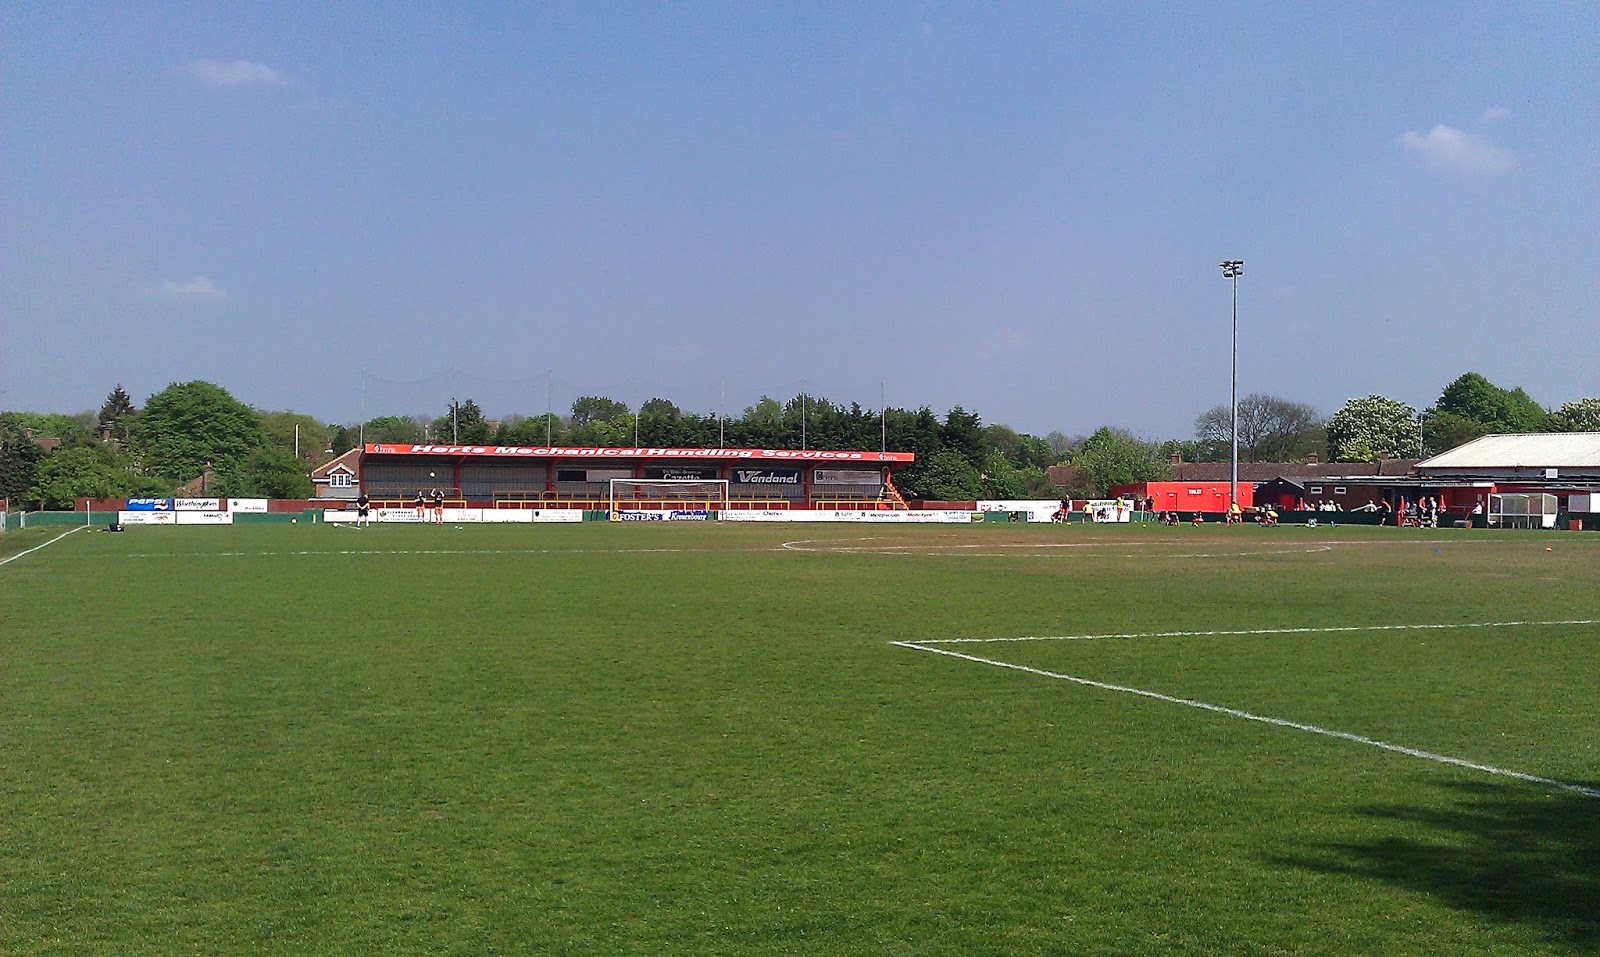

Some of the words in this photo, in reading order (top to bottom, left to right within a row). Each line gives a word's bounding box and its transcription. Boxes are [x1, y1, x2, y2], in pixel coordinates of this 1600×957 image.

[410, 445, 486, 453] Herts
[494, 447, 643, 455] Mechanical
[646, 449, 753, 457] Handling
[760, 450, 862, 458] Services
[738, 470, 799, 483] Vandanel
